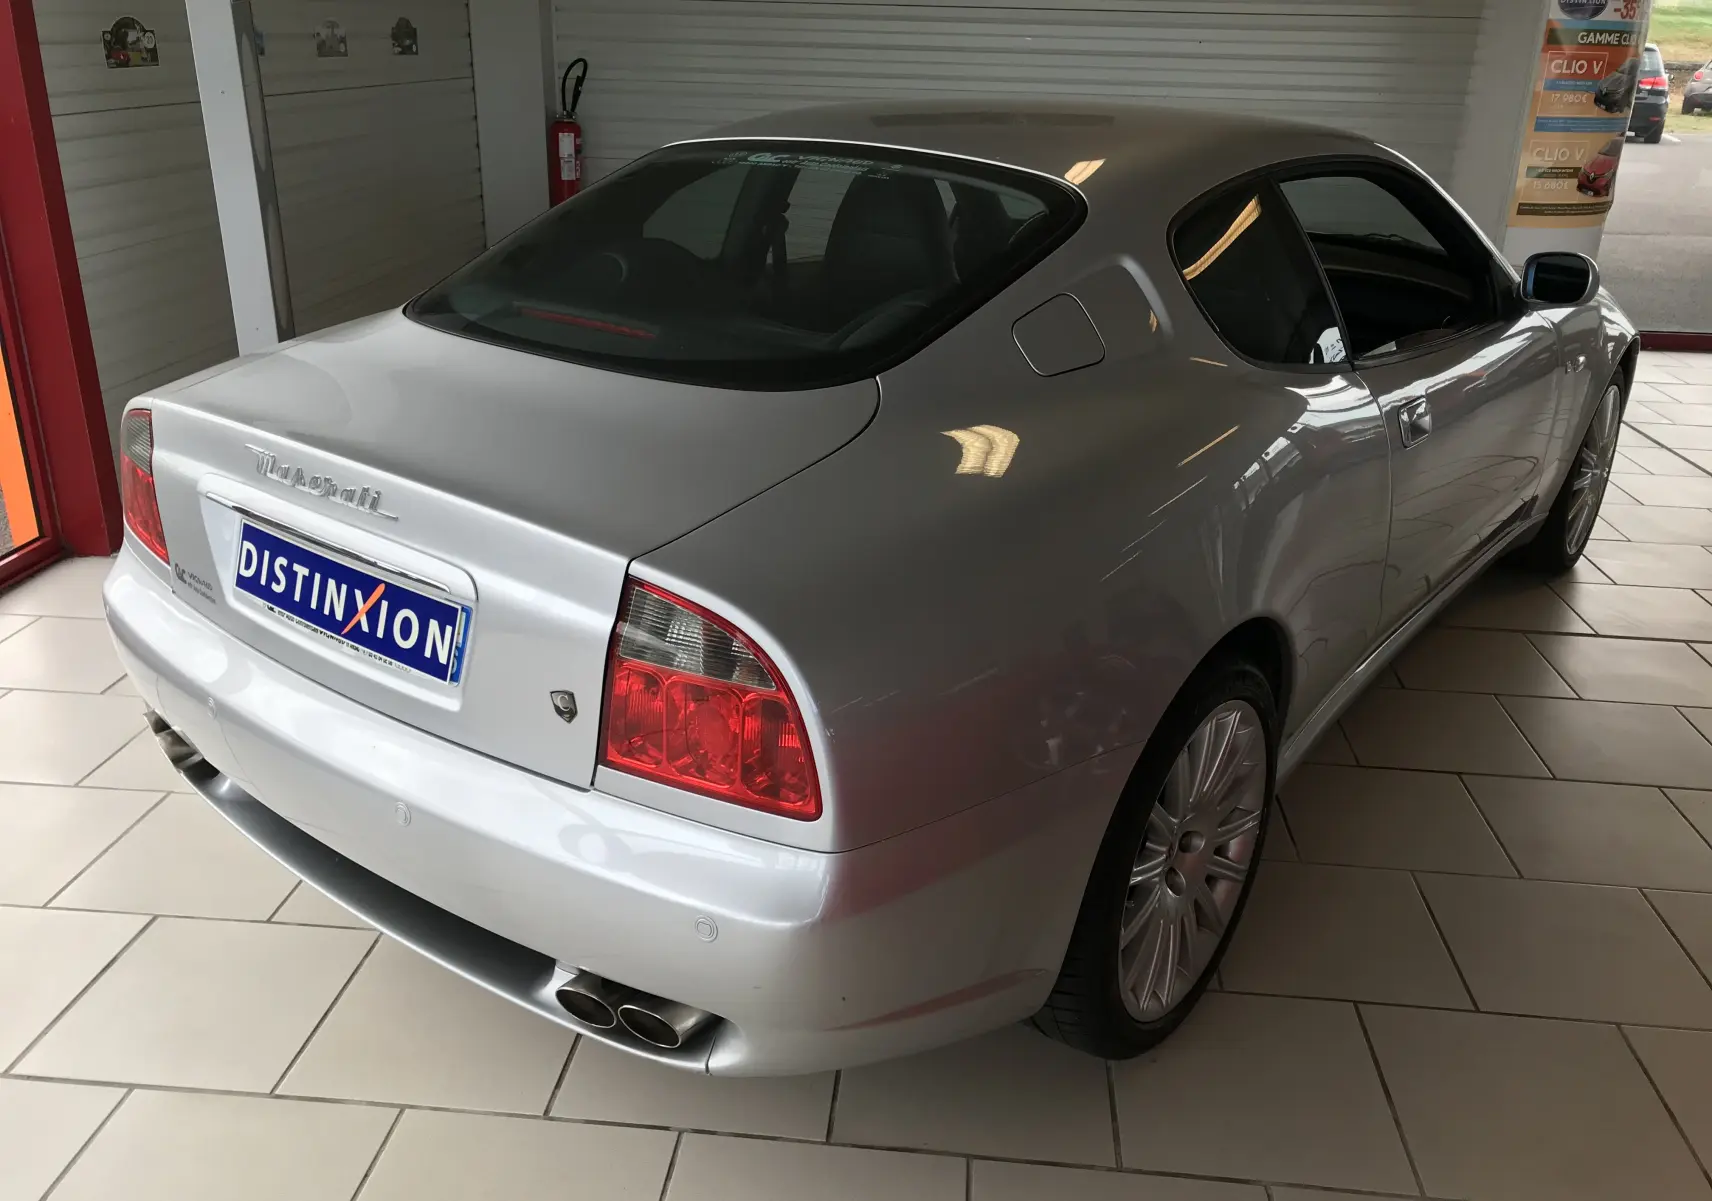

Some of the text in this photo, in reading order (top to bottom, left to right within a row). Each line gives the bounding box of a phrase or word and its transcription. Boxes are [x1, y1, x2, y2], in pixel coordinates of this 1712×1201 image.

[1578, 32, 1620, 45] GAMME
[1551, 59, 1603, 74] CLIO V
[1533, 147, 1584, 162] CLIO V
[244, 443, 400, 522] Maserati
[238, 539, 452, 666] DISTINXION
